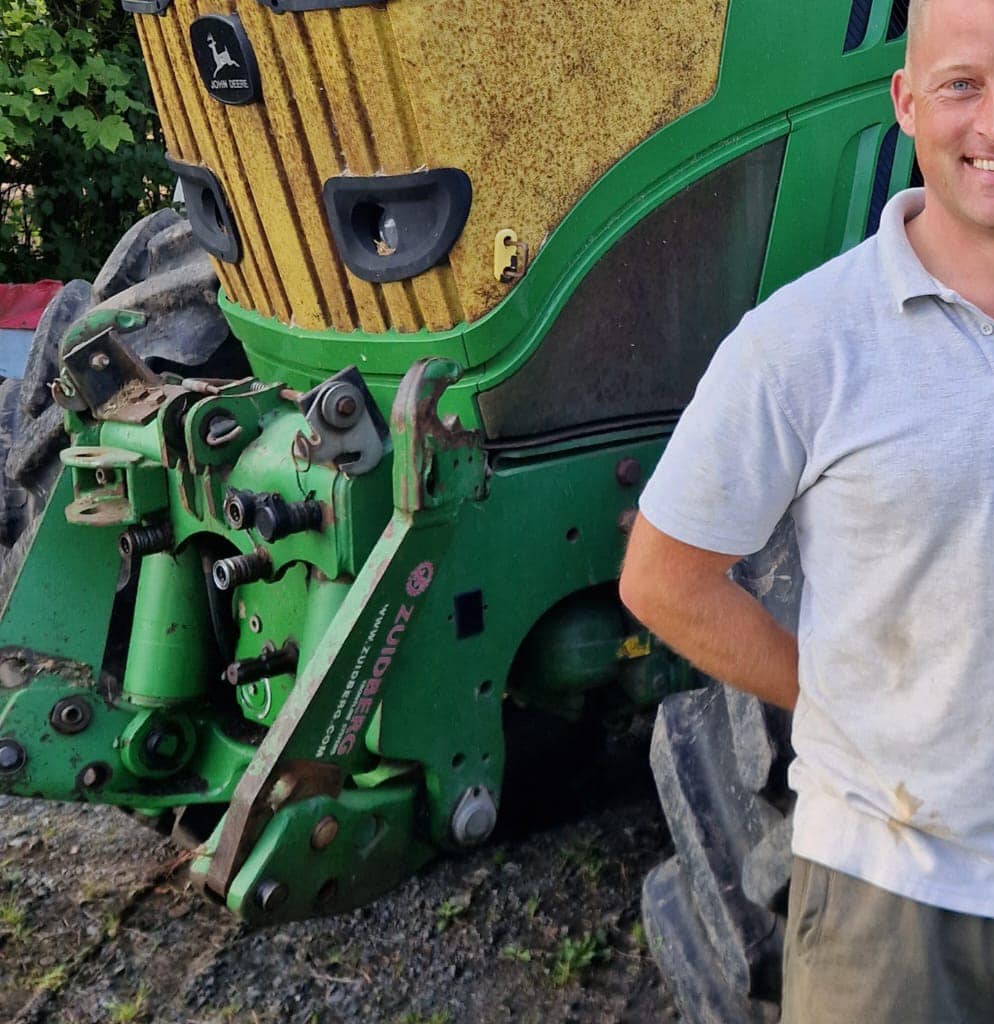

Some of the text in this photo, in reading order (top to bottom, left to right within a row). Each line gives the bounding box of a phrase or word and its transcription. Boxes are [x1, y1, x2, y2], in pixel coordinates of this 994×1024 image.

[210, 79, 250, 89] JOHN DEERE
[315, 603, 389, 758] WWW.ZUIDBERG.COM
[337, 604, 414, 756] ZUIDBERG
